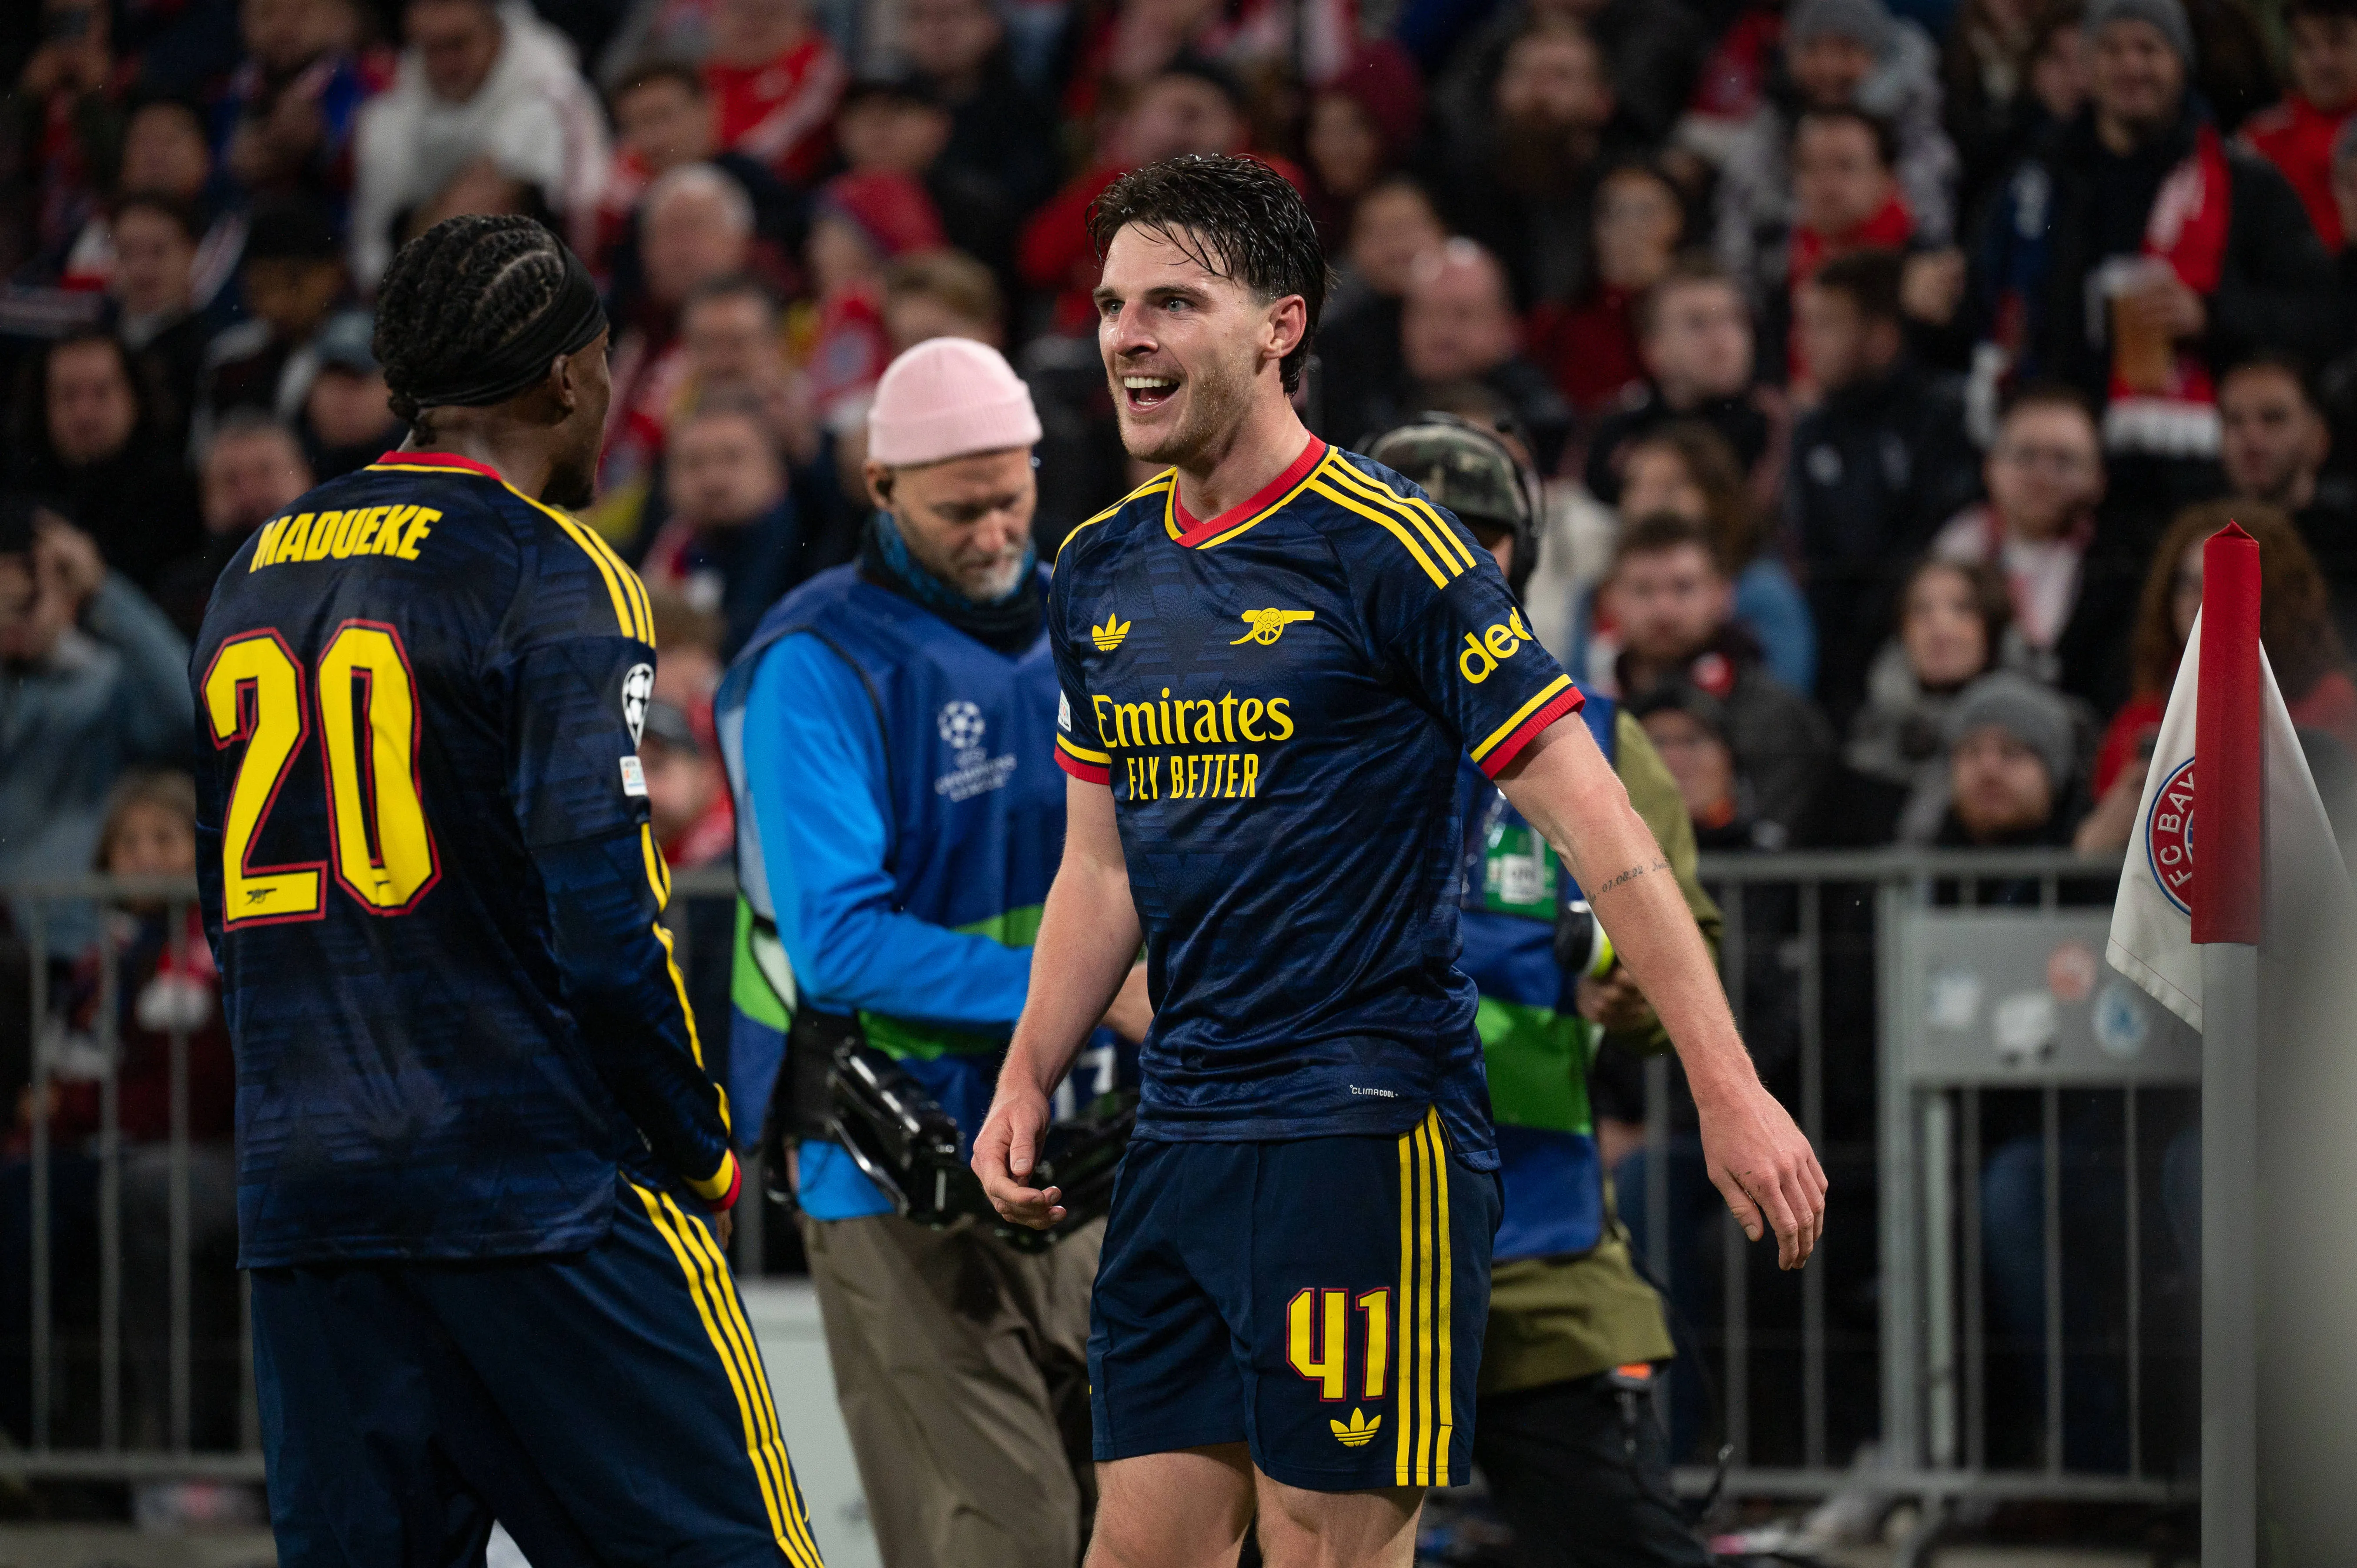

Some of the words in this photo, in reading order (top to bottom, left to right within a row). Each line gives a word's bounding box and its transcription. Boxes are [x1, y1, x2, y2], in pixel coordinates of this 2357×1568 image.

[250, 505, 443, 573] MADUEKE
[1091, 687, 1294, 749] Emirates
[201, 618, 442, 932] 20
[1127, 756, 1159, 800] FLY
[1170, 753, 1259, 799] BETTER
[2160, 846, 2192, 888] FC
[1286, 1287, 1390, 1402] 41
